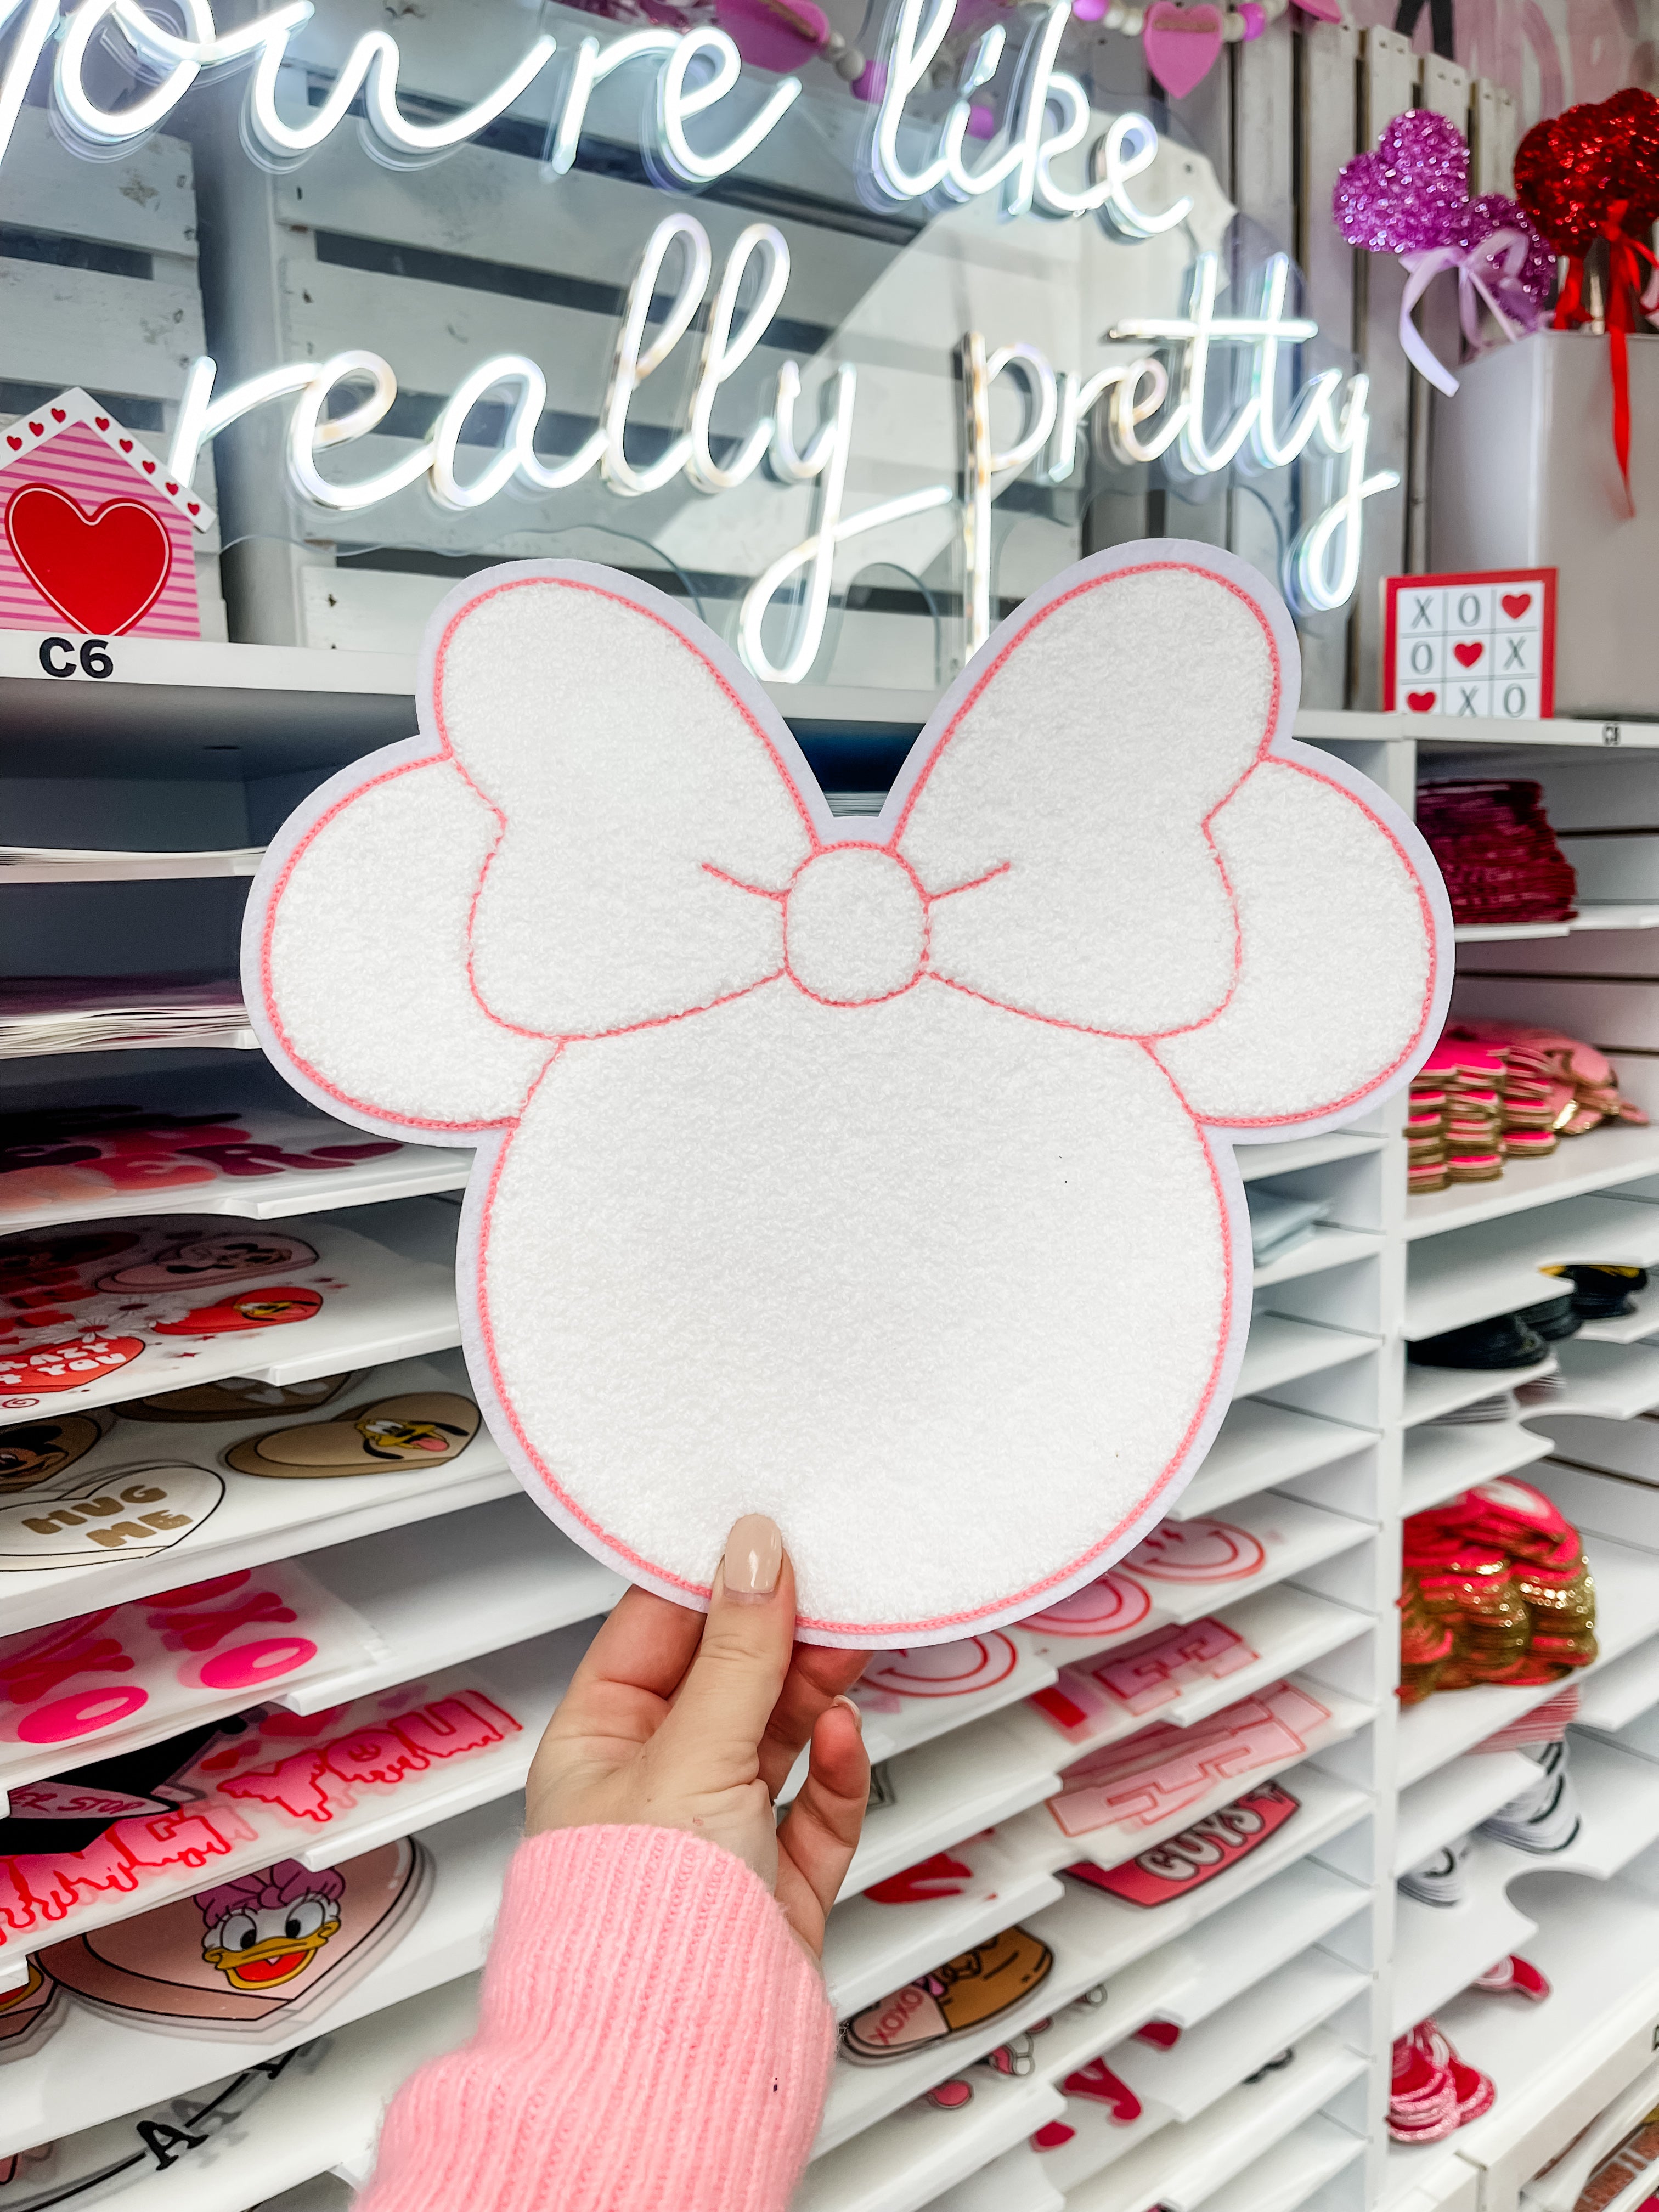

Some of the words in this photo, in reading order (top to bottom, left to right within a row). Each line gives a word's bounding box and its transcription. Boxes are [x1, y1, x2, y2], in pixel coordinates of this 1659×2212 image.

[872, 0, 1194, 237] like
[166, 213, 953, 682] really
[964, 251, 1400, 663] pretty
[39, 637, 114, 679] C6
[37, 1353, 127, 1376] YOU
[21, 1485, 167, 1534] HUG
[86, 1509, 194, 1548] ME
[57, 1796, 146, 1815] STOP
[1134, 1808, 1266, 1882] GUYS
[868, 1987, 924, 2046] XOXO
